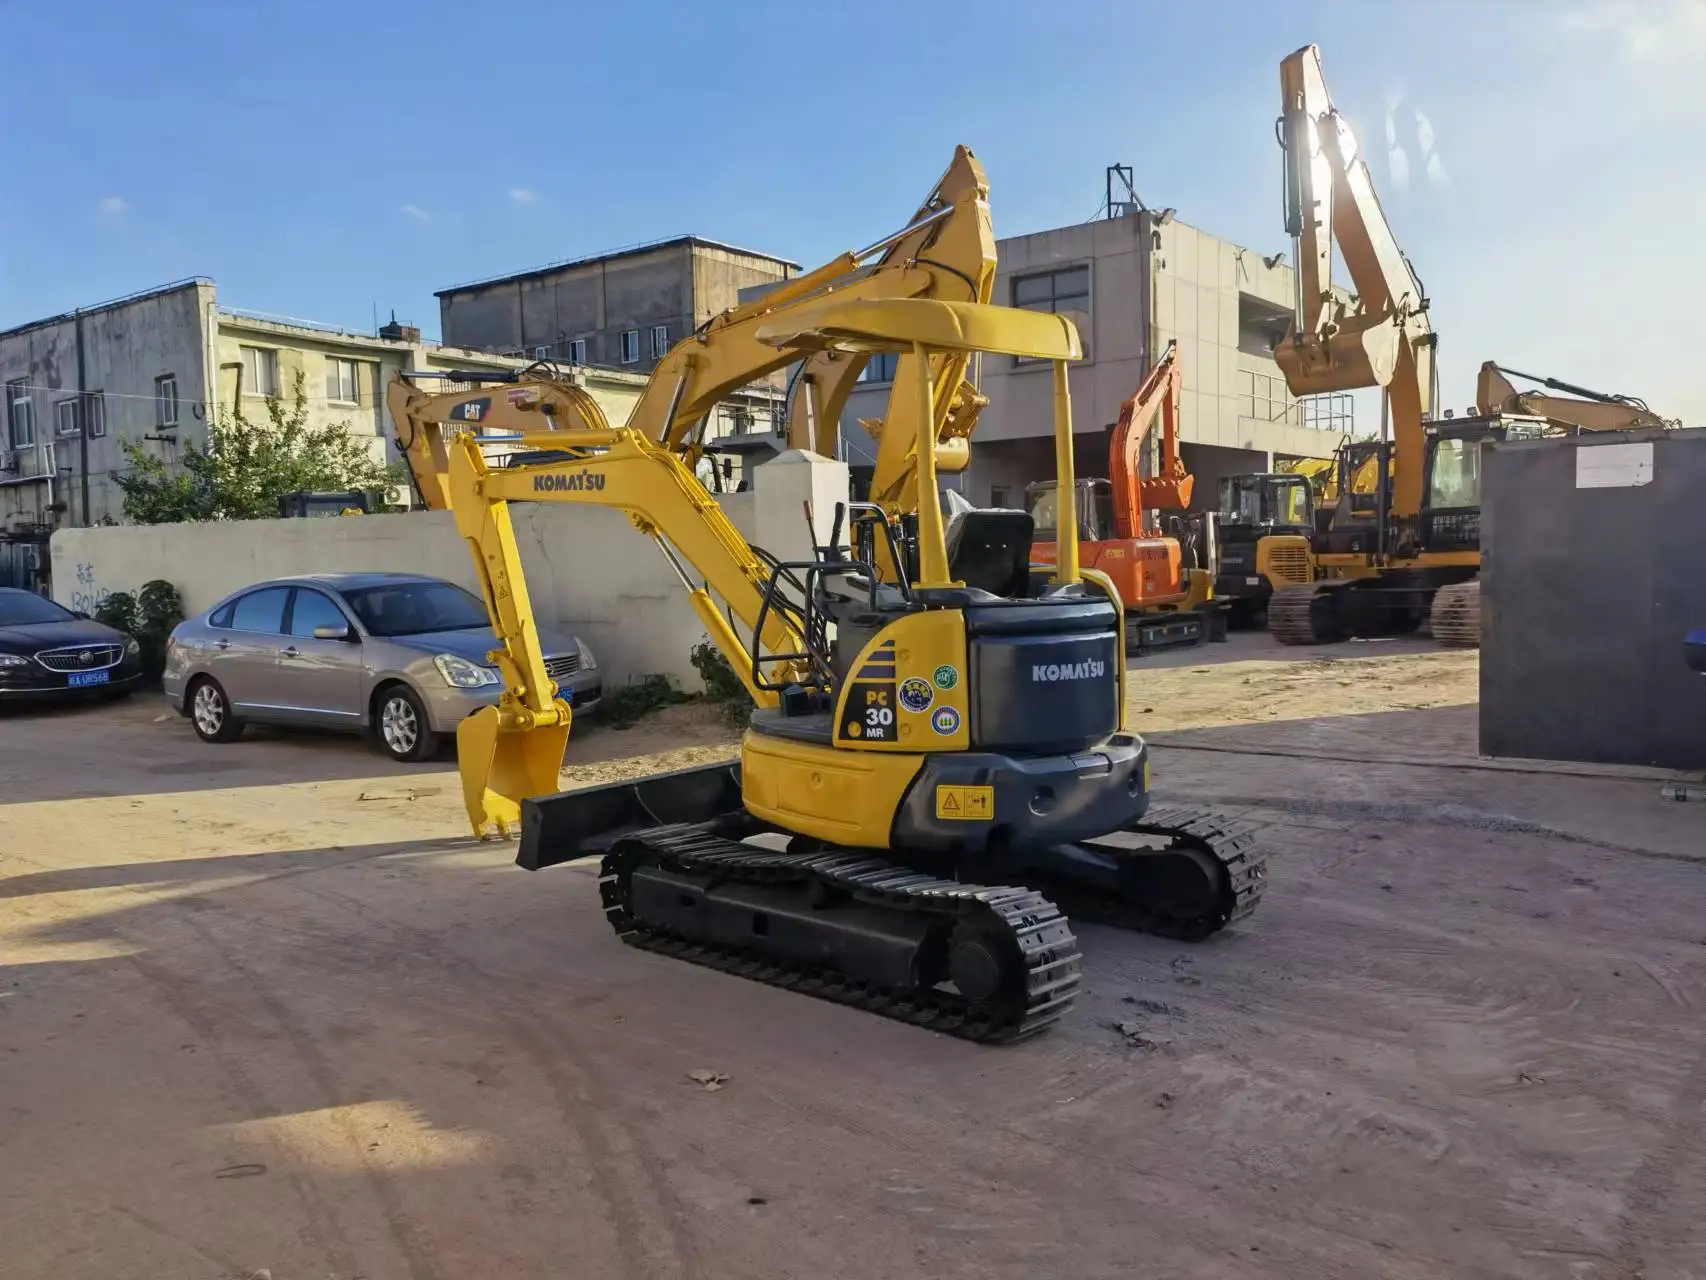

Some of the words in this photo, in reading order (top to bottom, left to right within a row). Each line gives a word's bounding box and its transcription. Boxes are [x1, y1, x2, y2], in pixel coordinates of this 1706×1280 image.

[464, 403, 481, 420] CAT
[533, 468, 606, 492] KOMATSU
[1032, 658, 1105, 682] KOMATSU
[865, 690, 888, 706] PC
[865, 707, 893, 726] 30
[866, 727, 885, 738] MR
